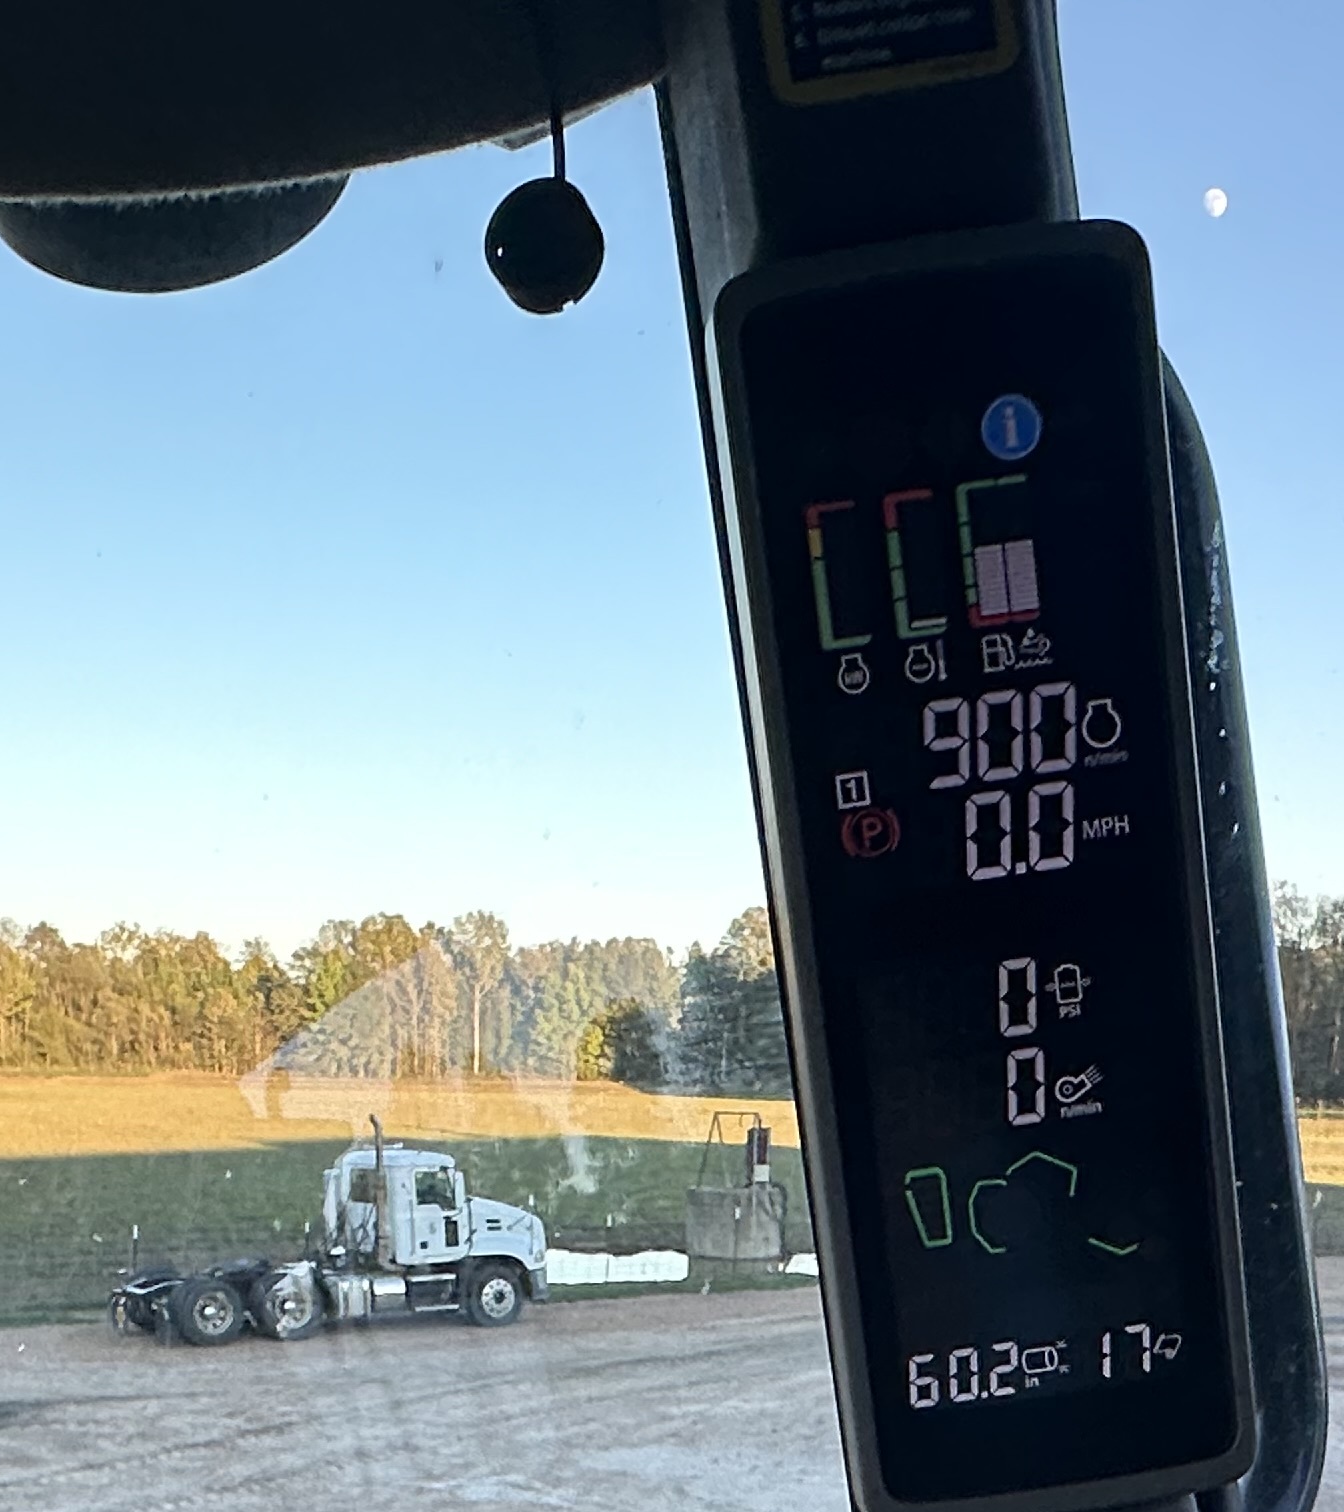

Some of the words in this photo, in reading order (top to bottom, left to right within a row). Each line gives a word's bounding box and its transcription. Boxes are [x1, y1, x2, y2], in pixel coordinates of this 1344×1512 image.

[923, 680, 1077, 789] 900
[845, 778, 857, 801] 1
[862, 816, 882, 848] P
[965, 780, 1074, 881] 0.0
[1082, 815, 1130, 840] MPH
[998, 956, 1037, 1037] 0
[1059, 1003, 1081, 1019] PSI
[1007, 1046, 1045, 1126] 0
[909, 1341, 1018, 1408] 60.2
[1102, 1323, 1151, 1378] 17
